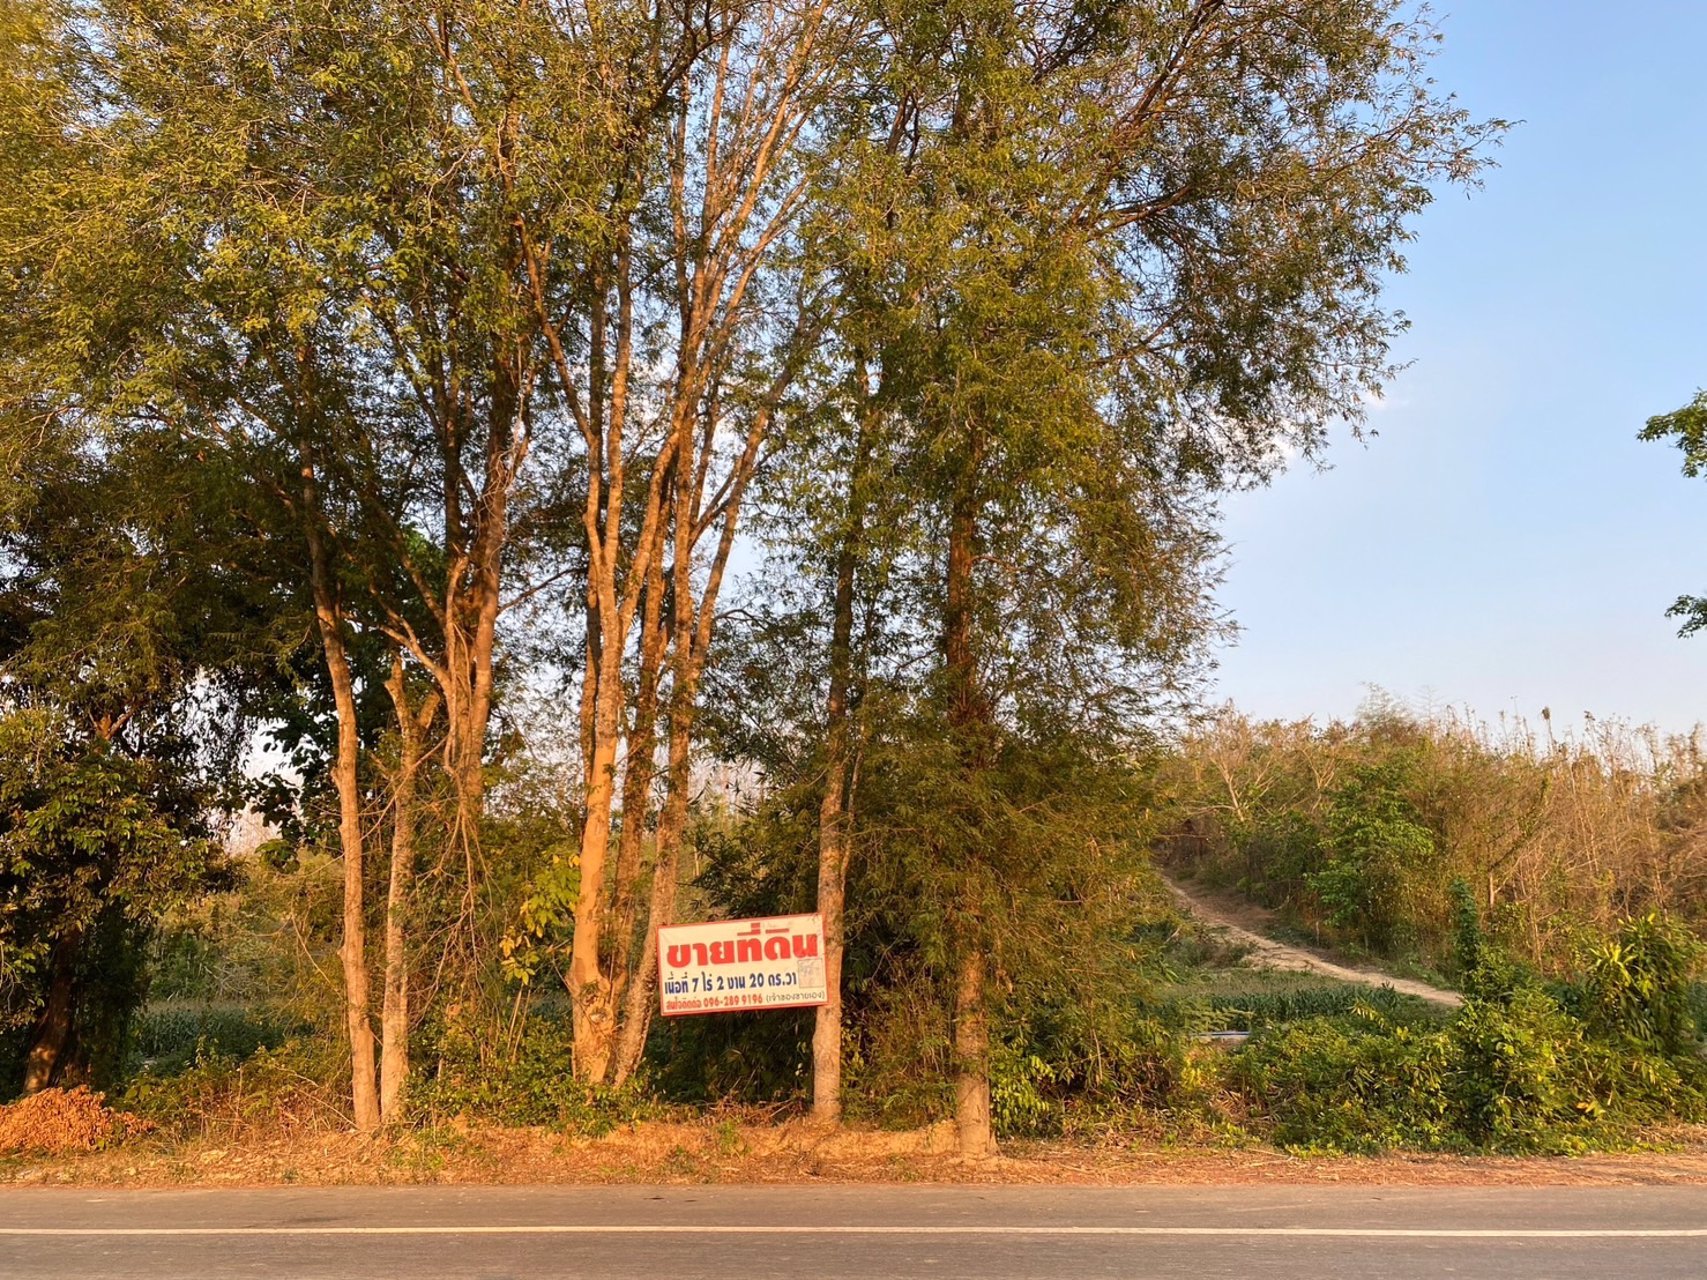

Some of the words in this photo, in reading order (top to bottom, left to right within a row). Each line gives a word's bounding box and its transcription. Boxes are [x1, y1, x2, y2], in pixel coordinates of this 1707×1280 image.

[667, 923, 819, 968] ขายที่ดิน
[692, 977, 699, 992] 7
[702, 972, 712, 992] ไร่
[717, 976, 724, 990] 2
[728, 976, 746, 990] งาน
[750, 973, 764, 987] 20
